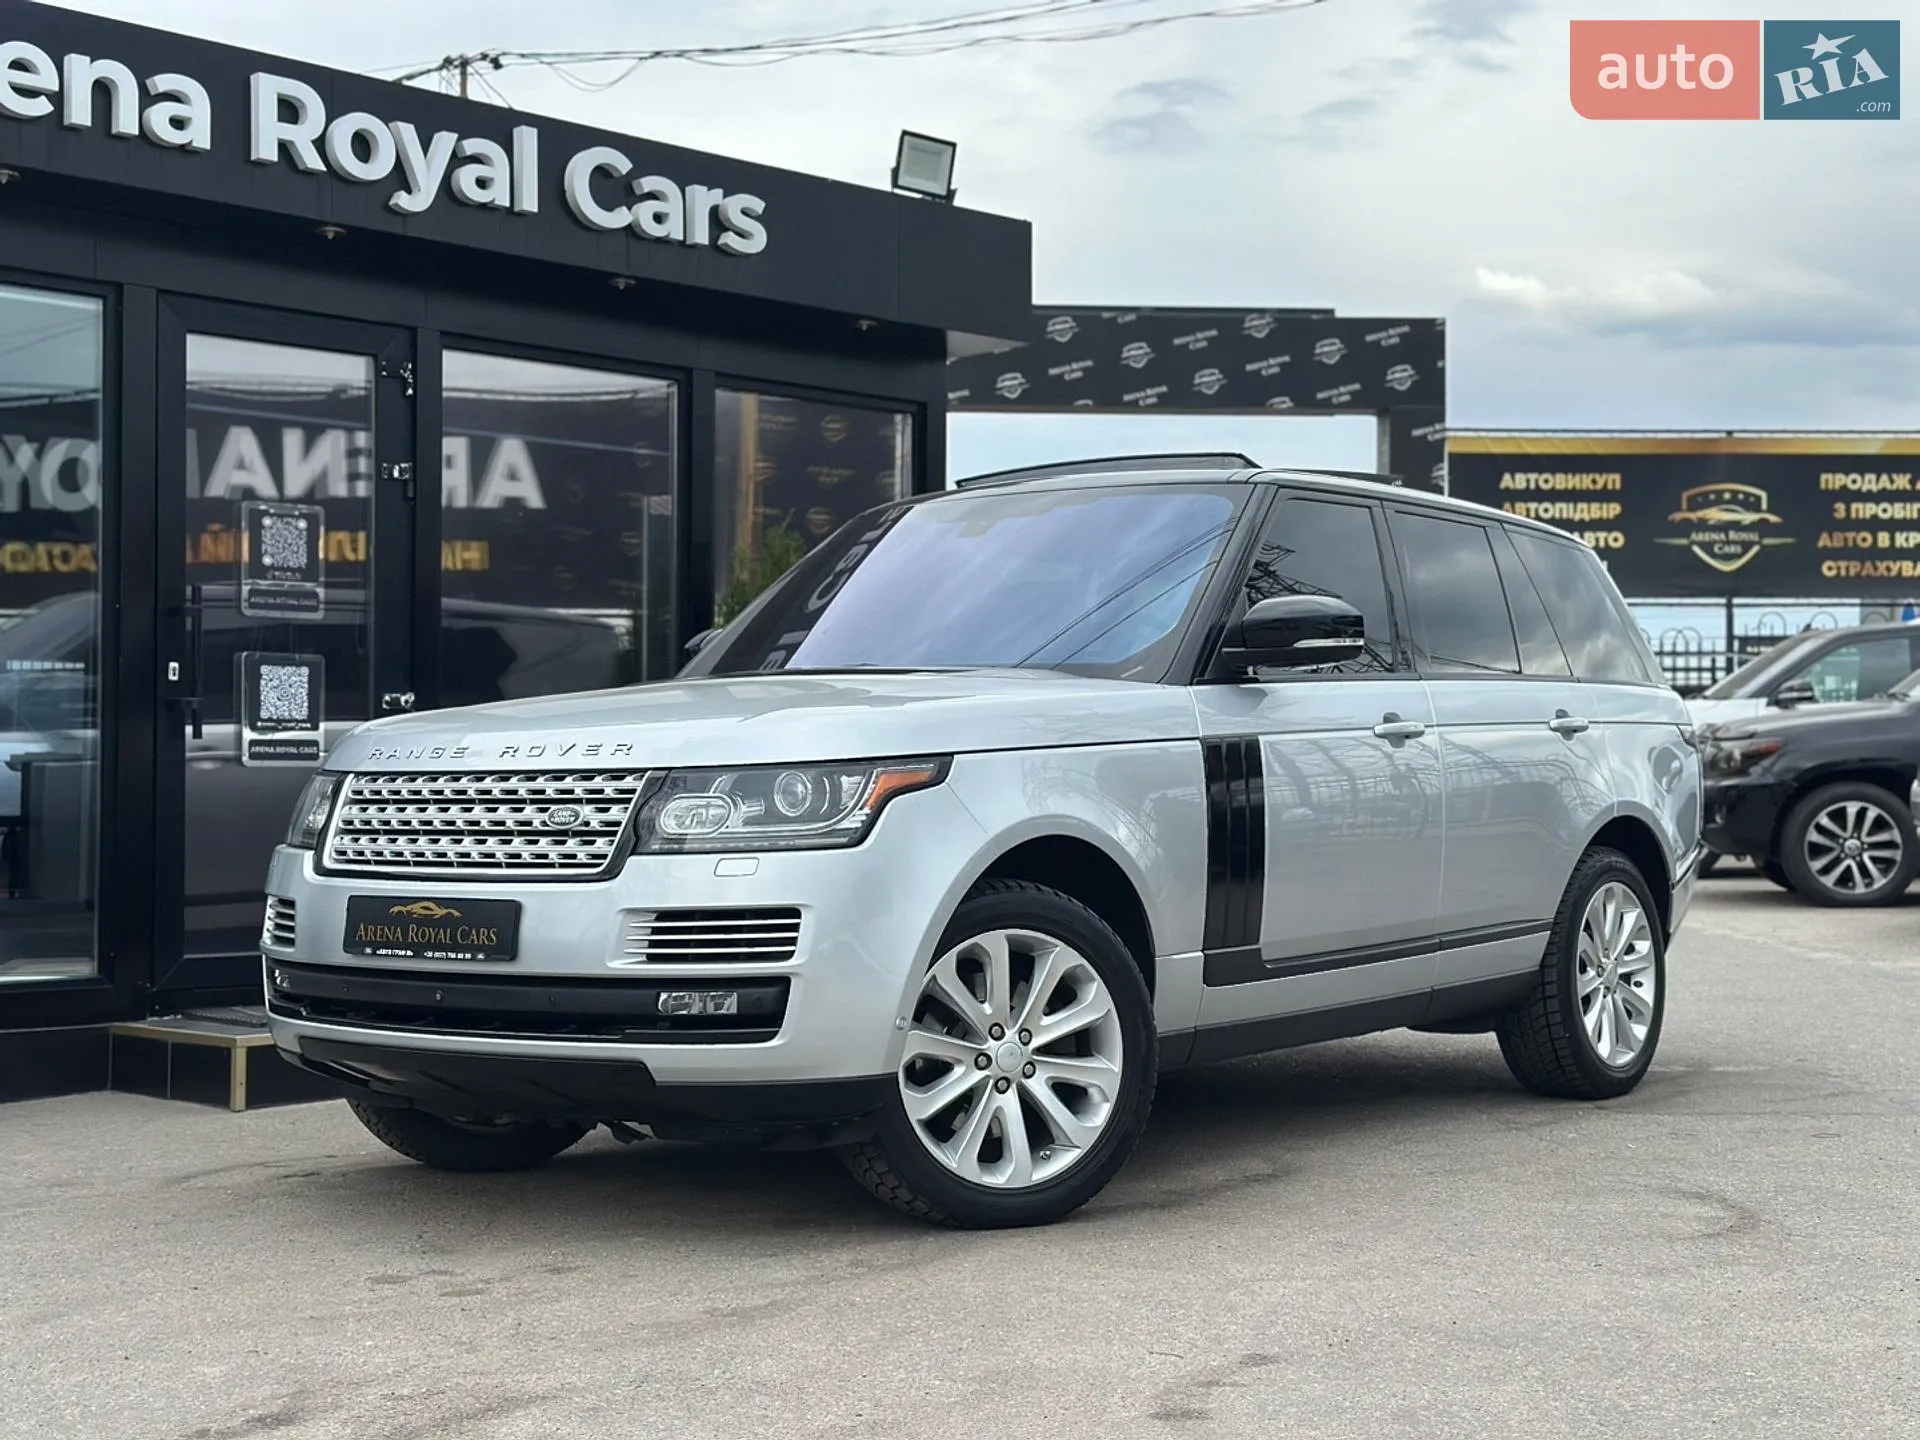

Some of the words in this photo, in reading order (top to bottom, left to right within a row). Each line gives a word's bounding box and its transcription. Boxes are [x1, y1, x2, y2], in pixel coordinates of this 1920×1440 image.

[0, 40, 211, 151] ena
[250, 72, 538, 214] Royal
[564, 147, 767, 255] Cars
[1500, 473, 1622, 490] АВТОВИКУП
[1820, 473, 1912, 493] ПРОДАЖ
[1817, 531, 1873, 549] АВТО
[367, 746, 471, 760] RANGE
[499, 743, 634, 758] ROVER
[355, 922, 403, 942] ARENA
[408, 924, 452, 944] ROYAL
[457, 926, 498, 946] CARS
